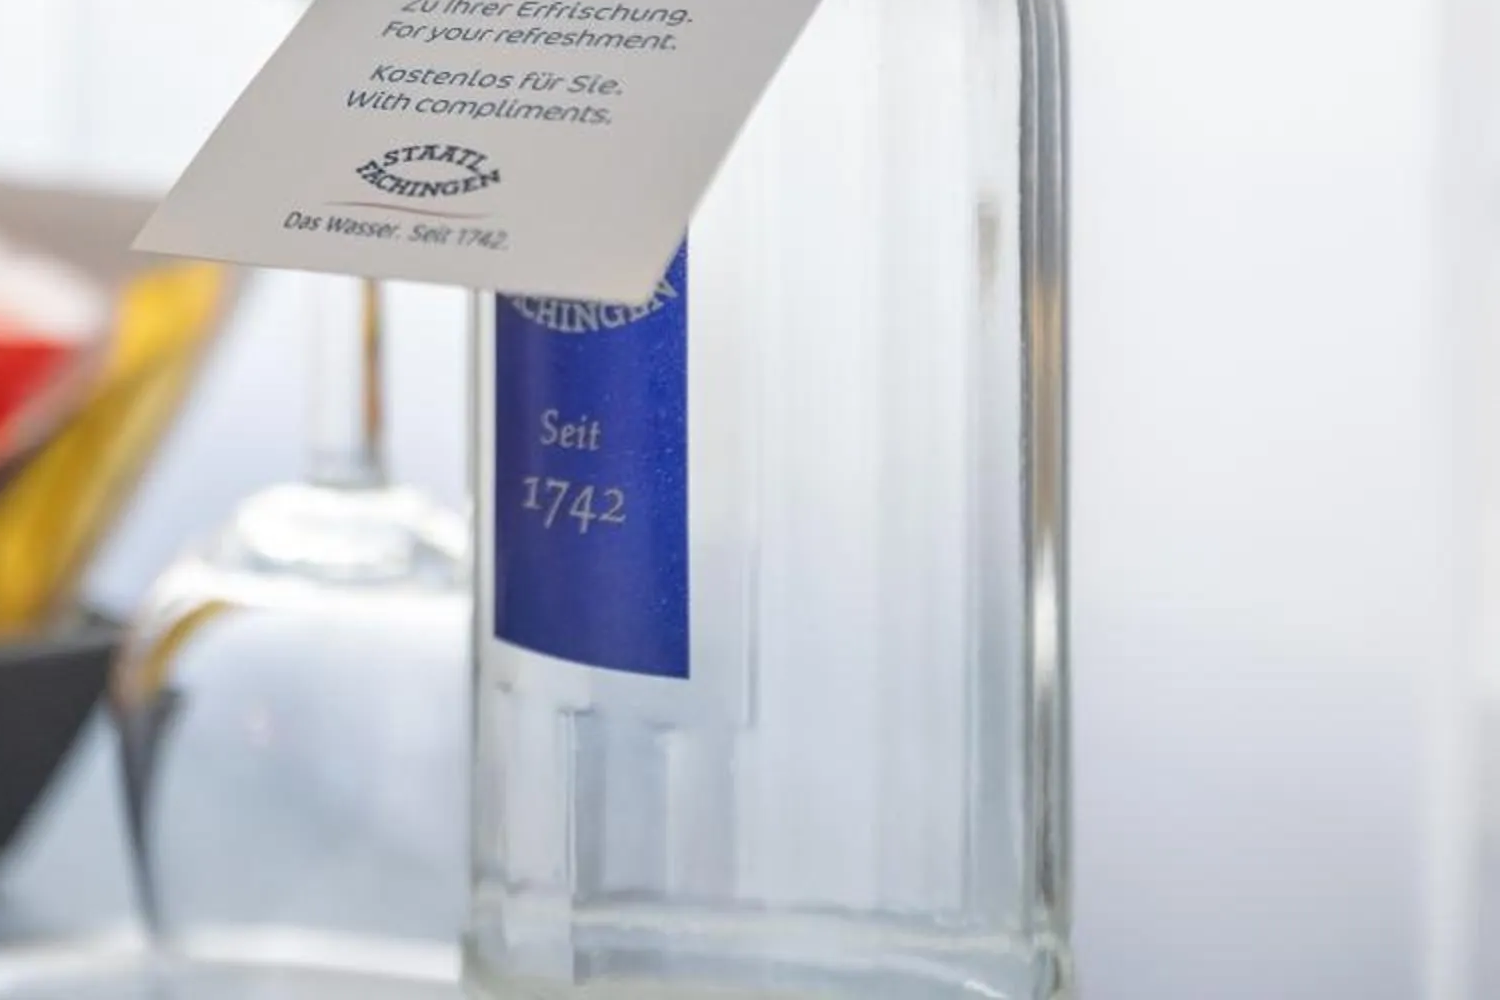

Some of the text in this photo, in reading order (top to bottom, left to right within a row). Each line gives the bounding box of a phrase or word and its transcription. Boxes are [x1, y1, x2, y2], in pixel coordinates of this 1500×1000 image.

[516, 0, 694, 27] Erfrischung.
[381, 21, 677, 51] For your refreshment.
[369, 64, 624, 96] Kostenlos für Sie.
[347, 90, 612, 125] With compliments.
[356, 160, 501, 198] FACHINGEN
[284, 211, 321, 231] Das
[326, 216, 400, 239] Wasser.
[408, 224, 452, 244] Seit
[540, 408, 601, 451] Seit
[521, 477, 627, 534] 1742
